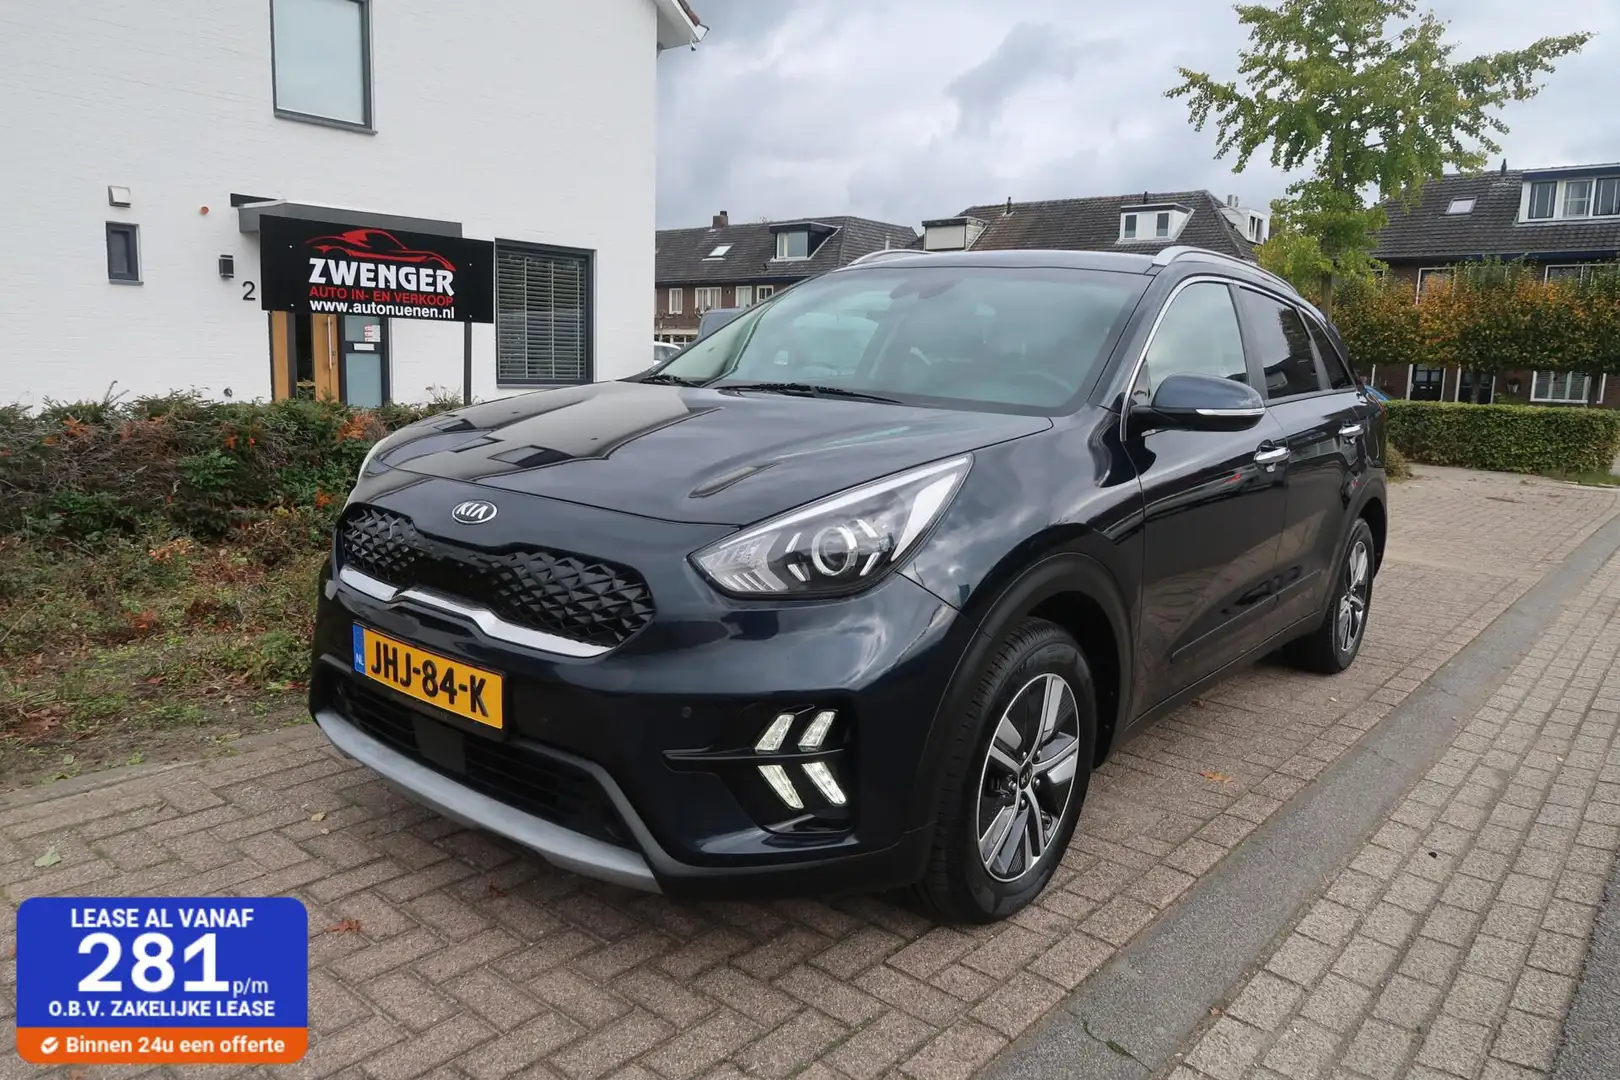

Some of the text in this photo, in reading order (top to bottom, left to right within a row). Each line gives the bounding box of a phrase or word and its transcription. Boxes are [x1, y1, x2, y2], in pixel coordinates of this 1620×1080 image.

[308, 257, 455, 297] ZWENGER
[242, 281, 256, 300] 2
[309, 286, 453, 306] AUTO IN- EN VERKOOP
[309, 300, 455, 319] www.autonuenen.nl
[456, 502, 489, 520] KIA
[355, 653, 364, 666] NL
[371, 640, 489, 718] JHJ-84-K
